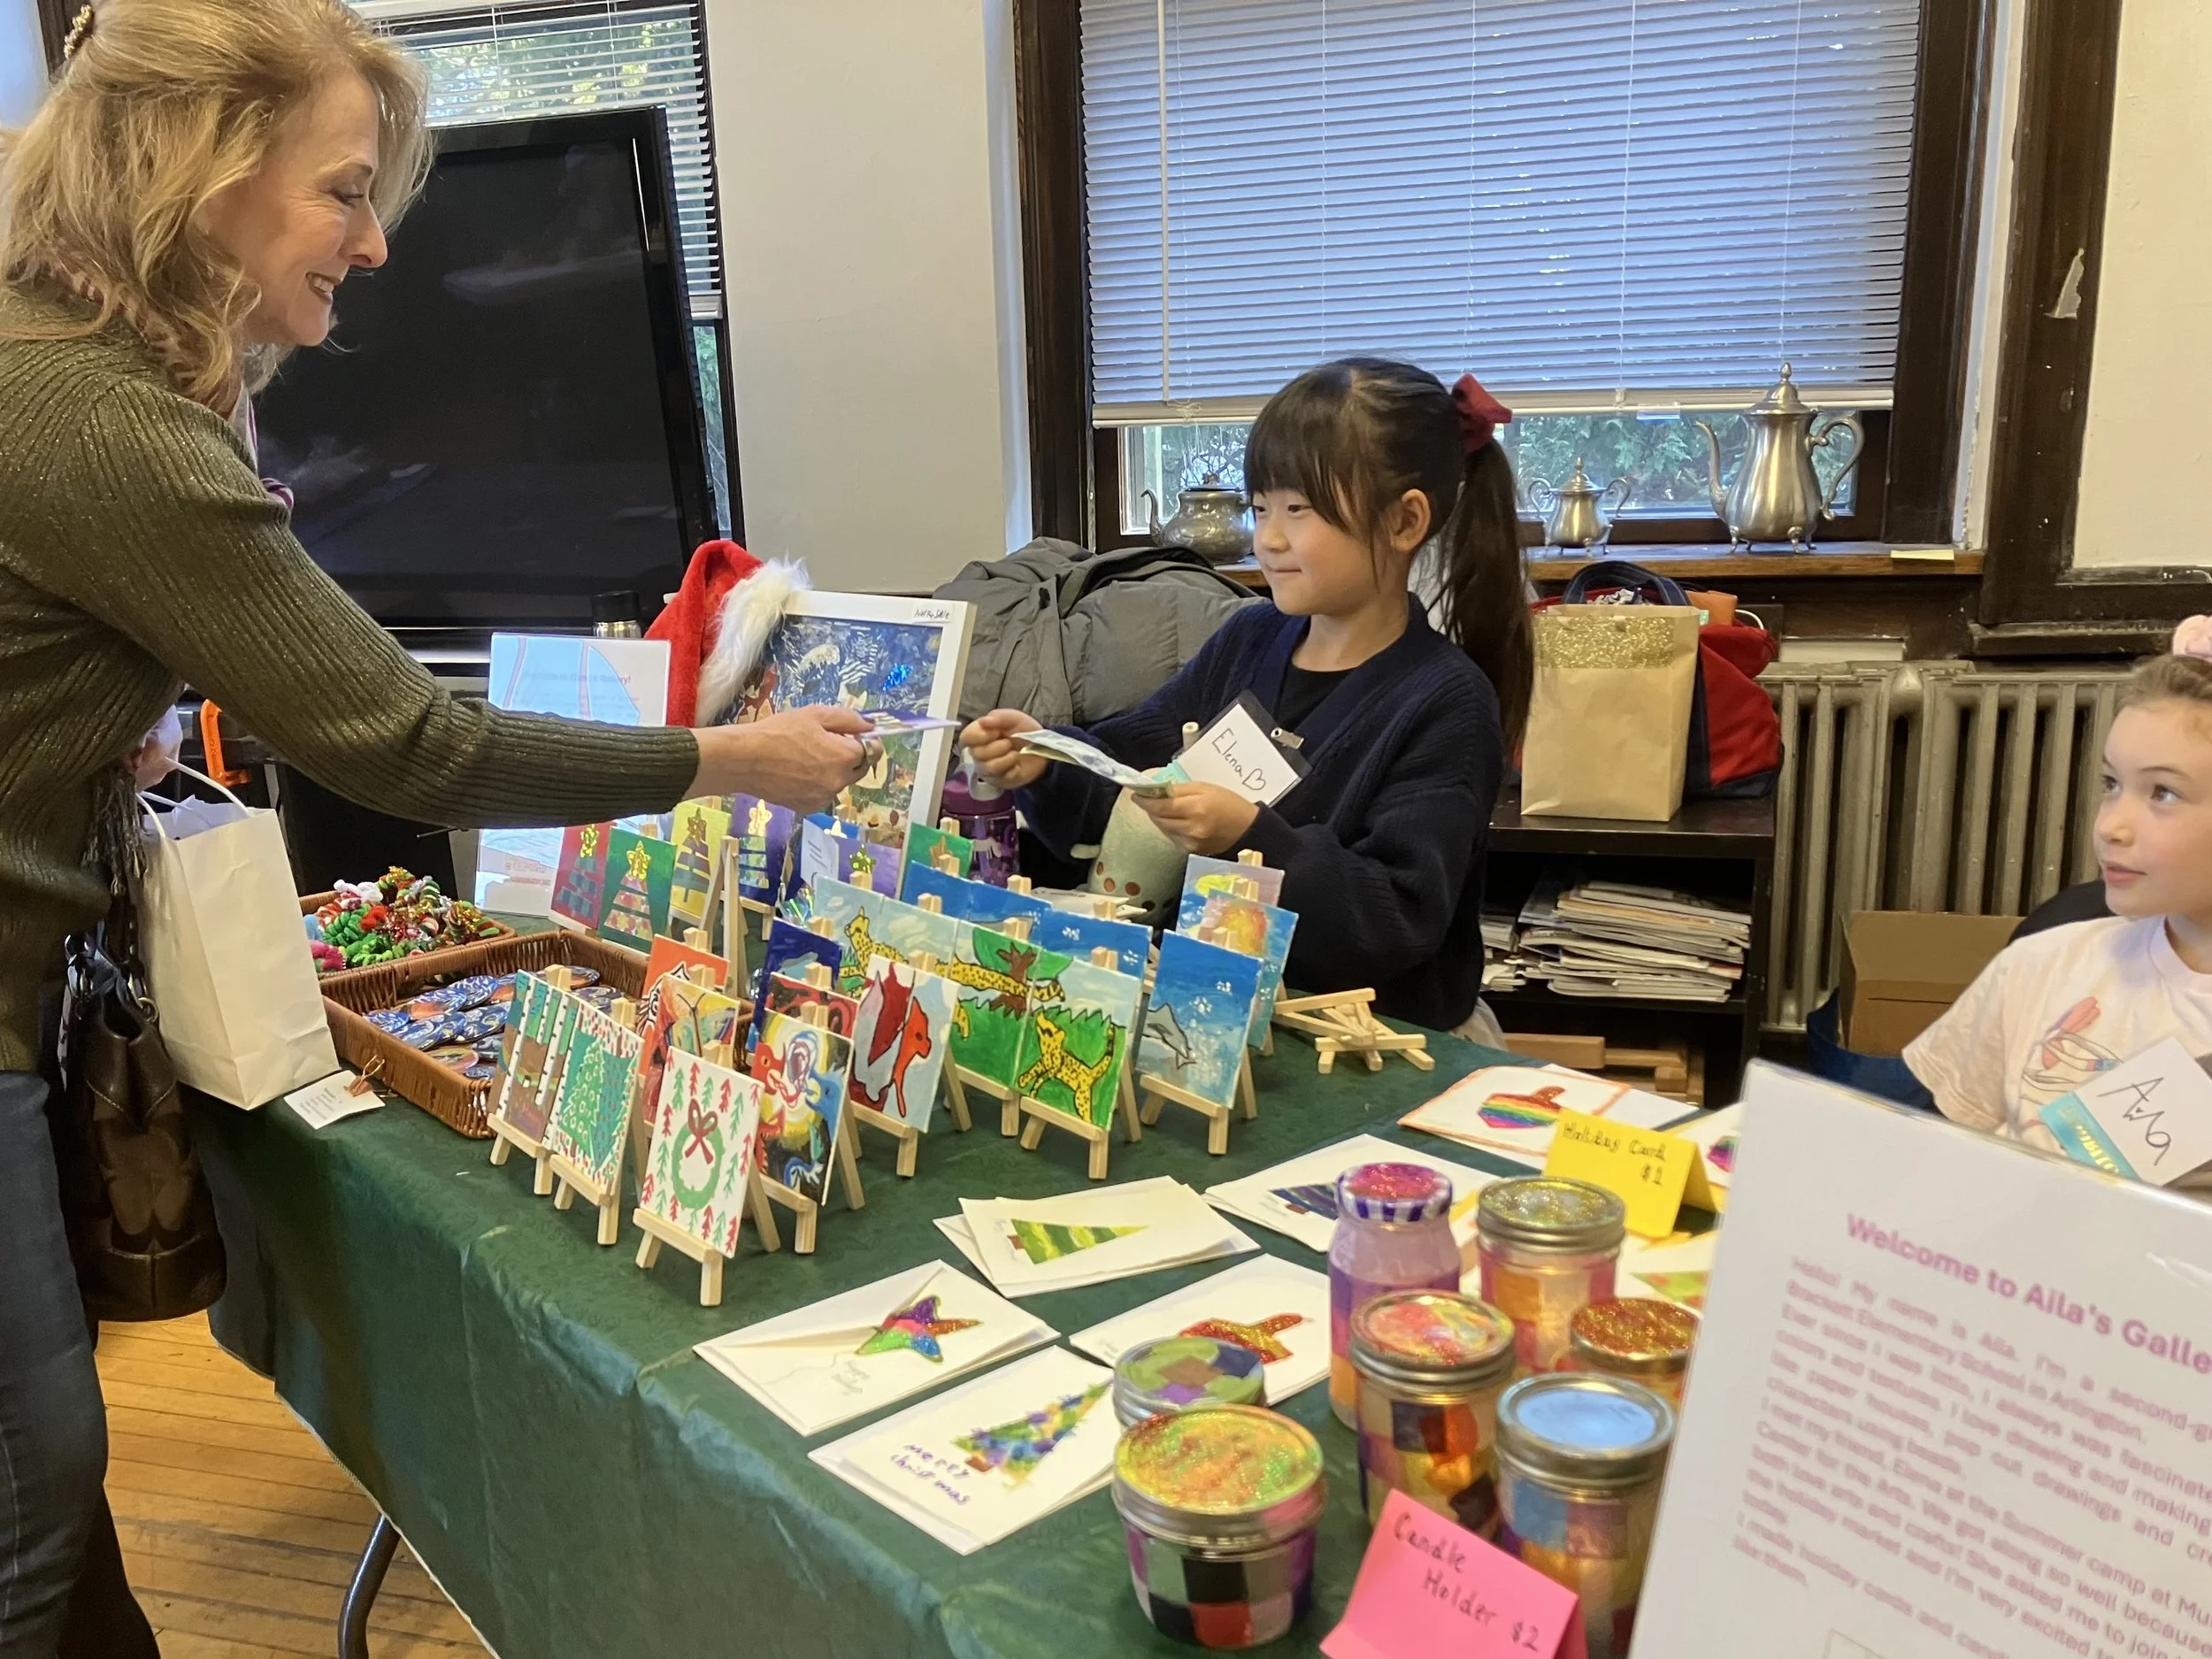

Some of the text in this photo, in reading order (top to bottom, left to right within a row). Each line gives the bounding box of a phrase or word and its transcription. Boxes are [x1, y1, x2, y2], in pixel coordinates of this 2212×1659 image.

[934, 609, 950, 619] Sale
[1211, 727, 1242, 777] Elena
[1628, 1139, 1667, 1162] Card
[1640, 1164, 1663, 1187] $1
[1847, 1214, 1979, 1284] Welcome
[1987, 1270, 2016, 1298] to
[2080, 1376, 2093, 1391] a
[2071, 1430, 2111, 1457] was
[2088, 1468, 2128, 1494] and
[2133, 1488, 2211, 1536] making
[1394, 1510, 1466, 1574] Candle
[2133, 1519, 2174, 1546] and
[2186, 1542, 2212, 1568] cr
[2087, 1558, 2145, 1595] camp
[2151, 1588, 2170, 1607] at
[1423, 1566, 1539, 1653] Holder $2
[2020, 1610, 2090, 1656] excited
[2047, 1565, 2070, 1586] so
[2077, 1581, 2116, 1610] well
[2123, 1601, 2212, 1658] because
[2067, 1606, 2099, 1631] me
[2104, 1623, 2125, 1645] to
